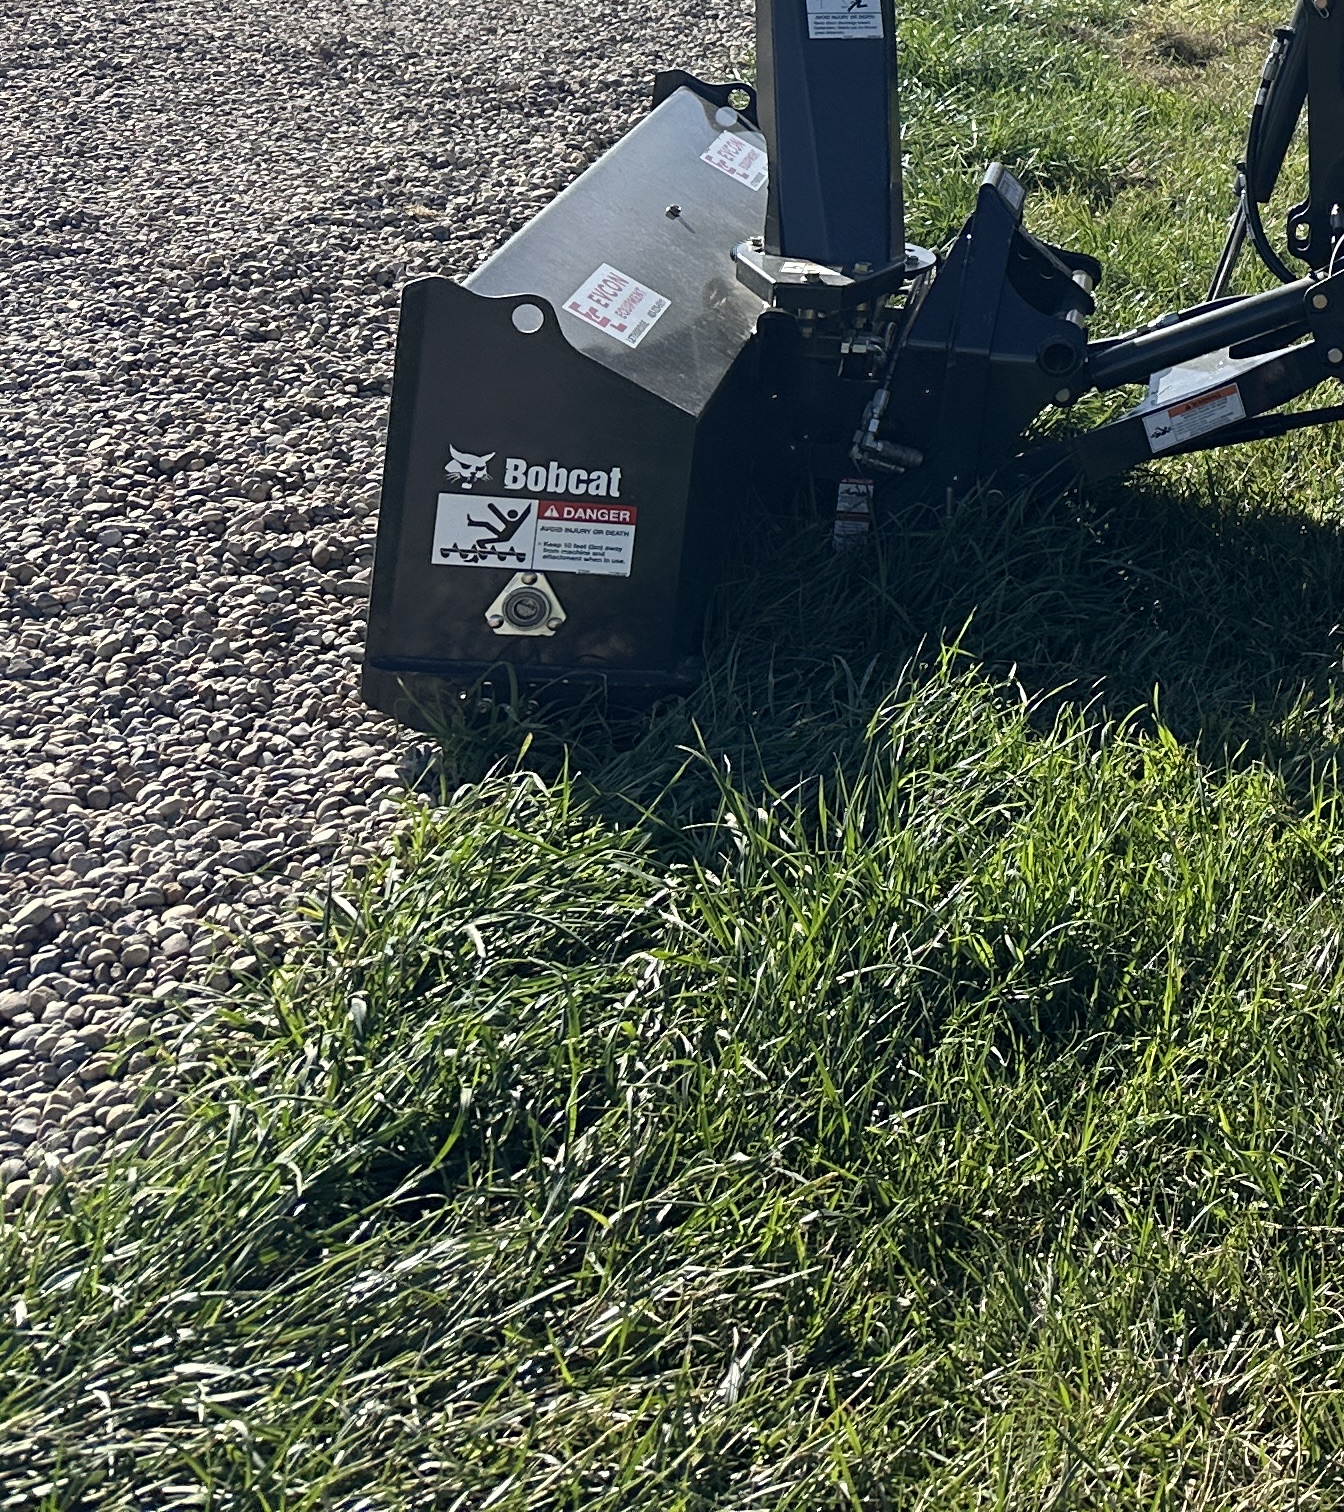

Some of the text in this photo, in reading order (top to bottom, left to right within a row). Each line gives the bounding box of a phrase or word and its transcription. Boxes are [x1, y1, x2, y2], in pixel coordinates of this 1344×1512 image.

[587, 272, 630, 308] EVCON
[503, 457, 622, 498] Bobcat
[562, 506, 631, 522] DANGER
[564, 527, 592, 536] INJURY
